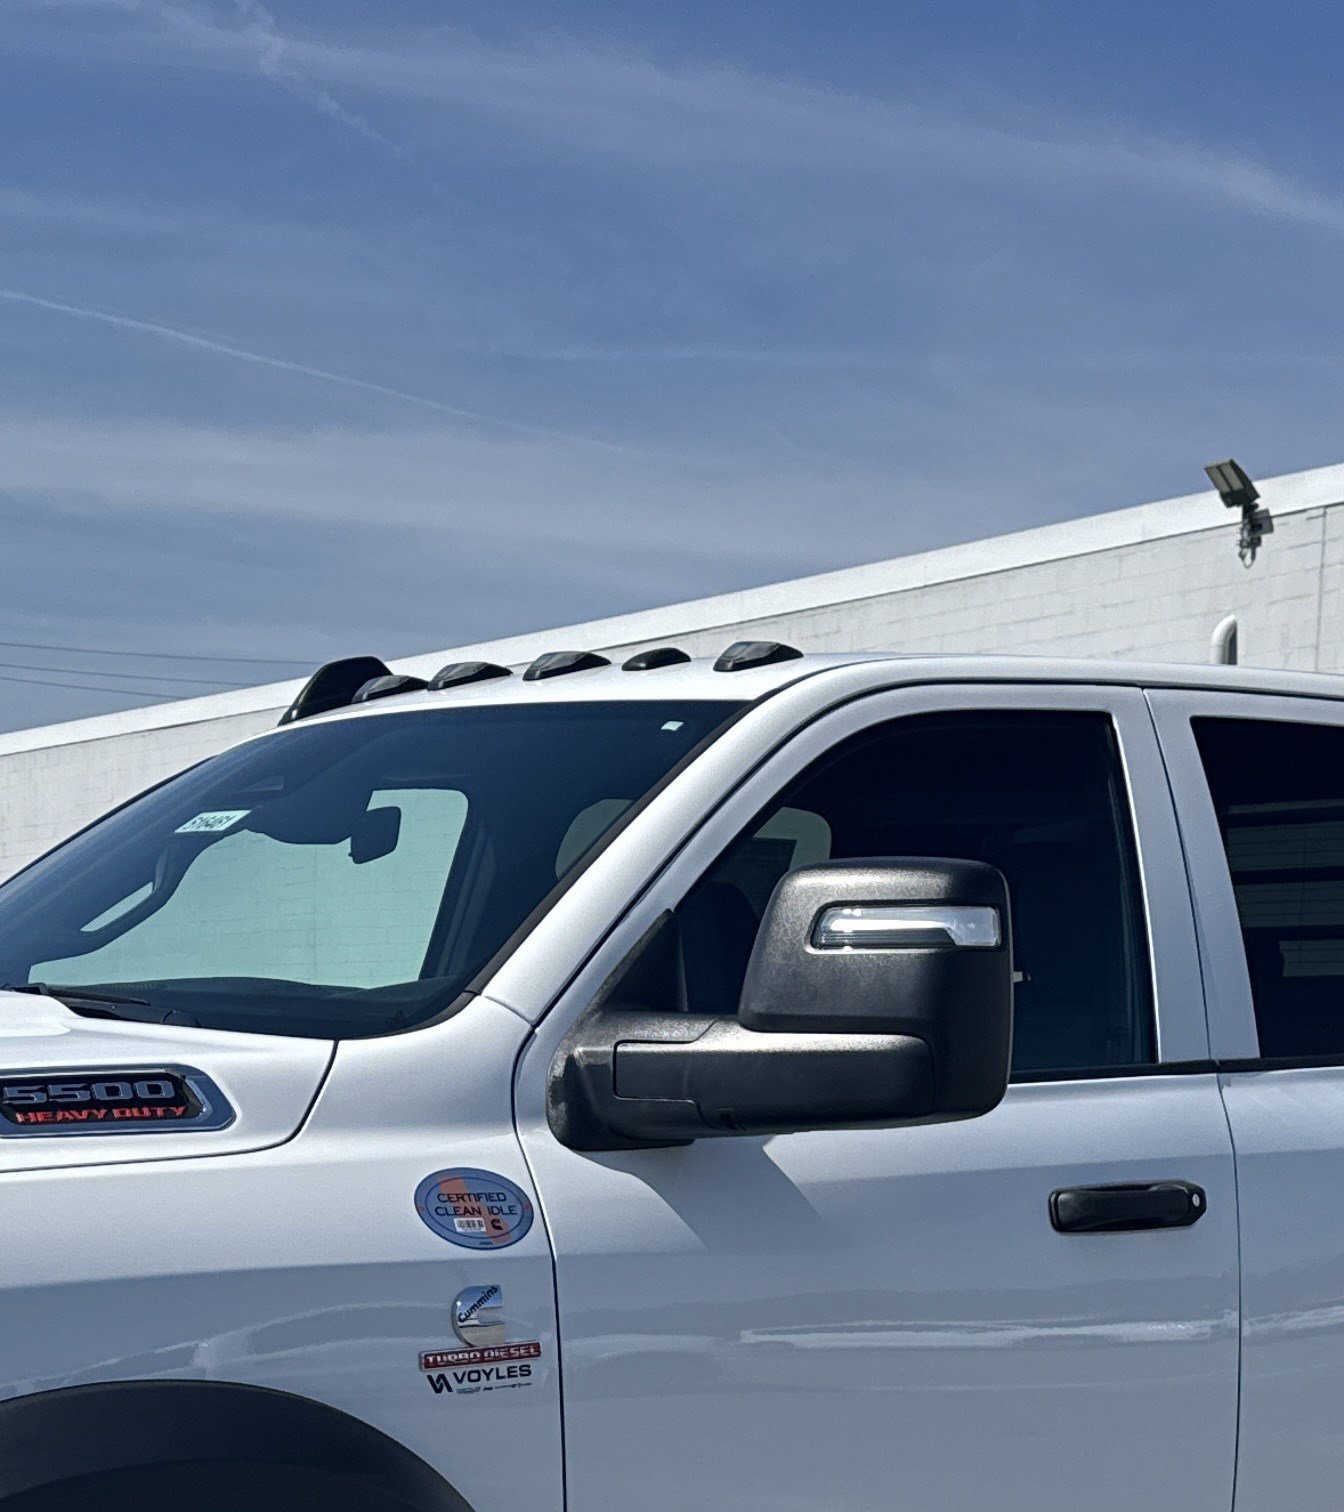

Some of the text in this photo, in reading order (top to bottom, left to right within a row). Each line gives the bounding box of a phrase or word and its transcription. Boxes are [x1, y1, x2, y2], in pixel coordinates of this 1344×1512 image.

[3, 1080, 175, 1104] 5500
[16, 1106, 186, 1122] HEAVY DUTY
[437, 1192, 507, 1203] CERTIFIED
[435, 1205, 518, 1216] CLEAN IDLE
[458, 1285, 498, 1323] Cummins
[426, 1345, 539, 1364] TURBO DIESEL
[453, 1364, 532, 1384] VOYLES
